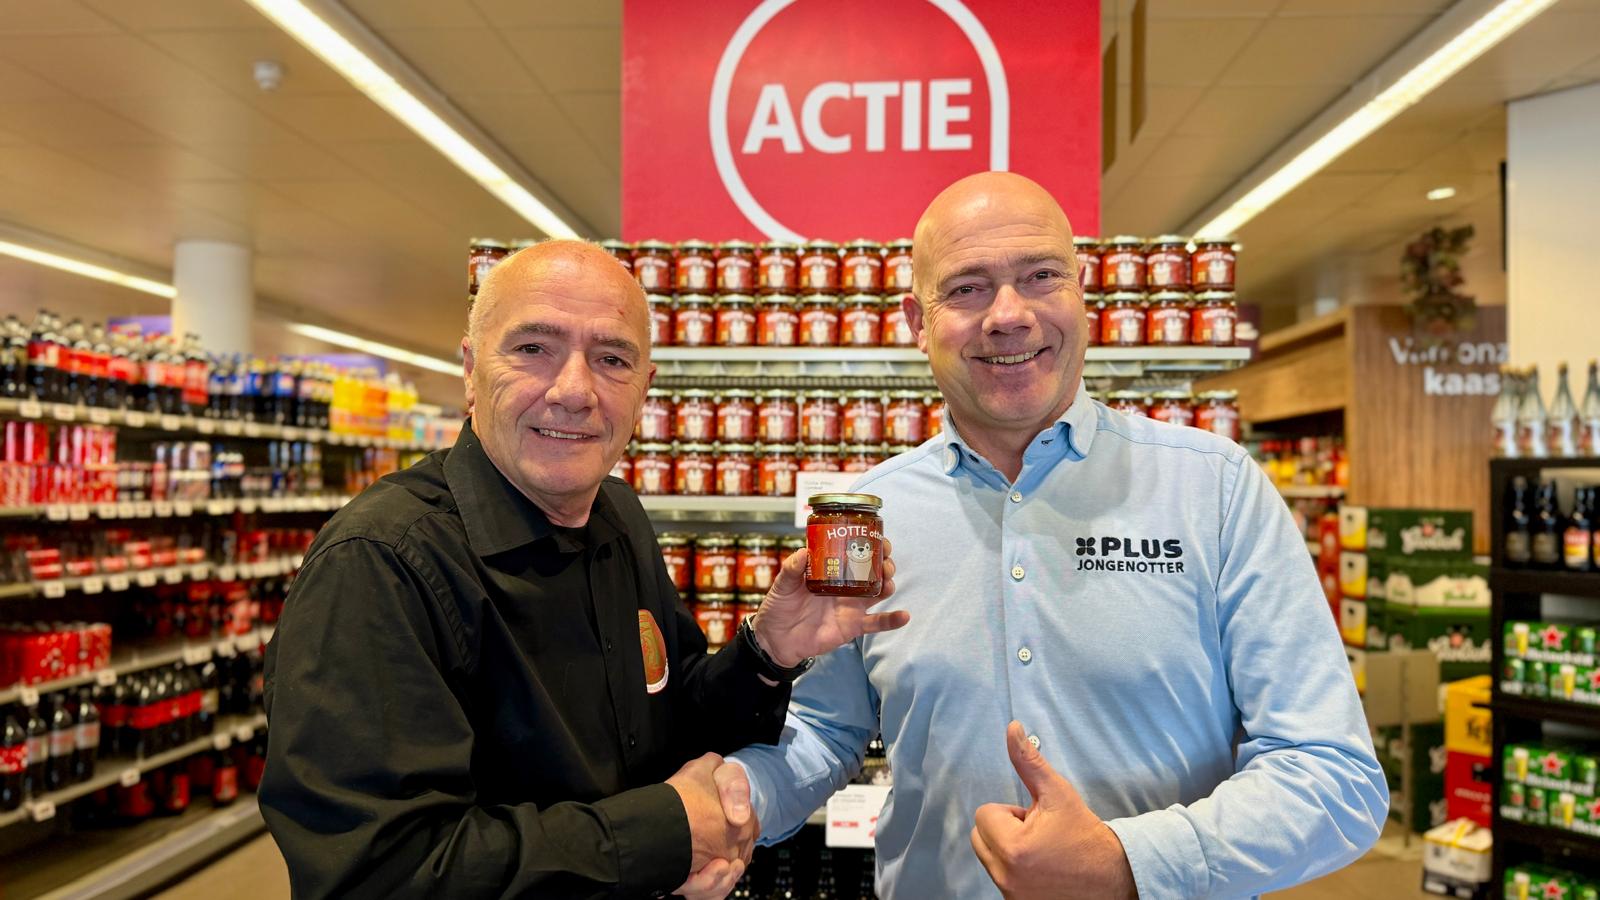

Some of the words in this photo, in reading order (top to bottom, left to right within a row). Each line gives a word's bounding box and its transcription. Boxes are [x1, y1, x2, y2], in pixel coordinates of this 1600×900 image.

[742, 79, 973, 154] ACTIE
[1423, 366, 1501, 396] kaas
[827, 525, 868, 540] HOTTE
[1101, 536, 1183, 559] PLUS
[1077, 559, 1184, 574] JONGENOTTER
